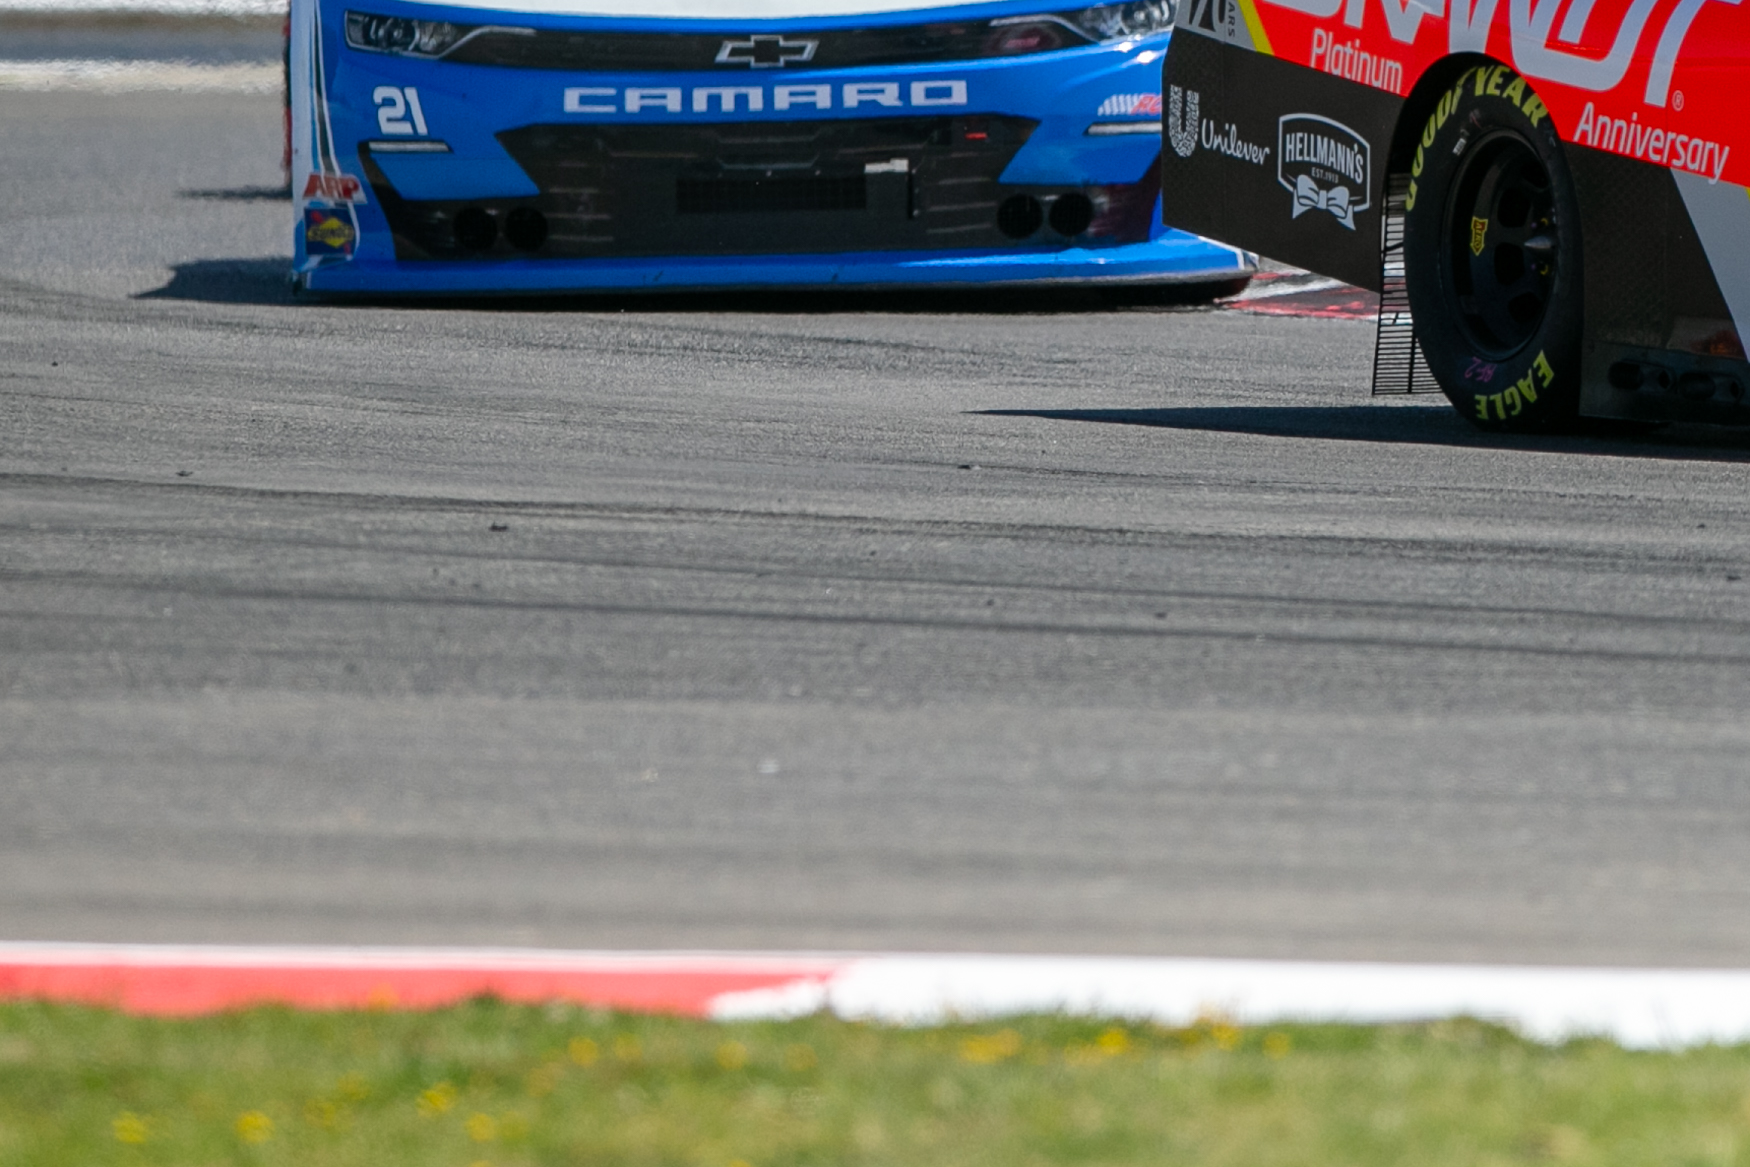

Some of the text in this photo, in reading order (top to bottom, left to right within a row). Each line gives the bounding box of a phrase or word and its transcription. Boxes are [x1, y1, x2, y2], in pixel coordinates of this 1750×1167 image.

[1310, 27, 1403, 94] Platinum
[373, 86, 429, 136] 21
[563, 78, 968, 115] CAMARO
[1201, 118, 1270, 165] Unilever
[1285, 132, 1364, 184] HELLMANN'S
[1573, 101, 1730, 184] Anniversary
[1474, 349, 1555, 421] EAGLE
